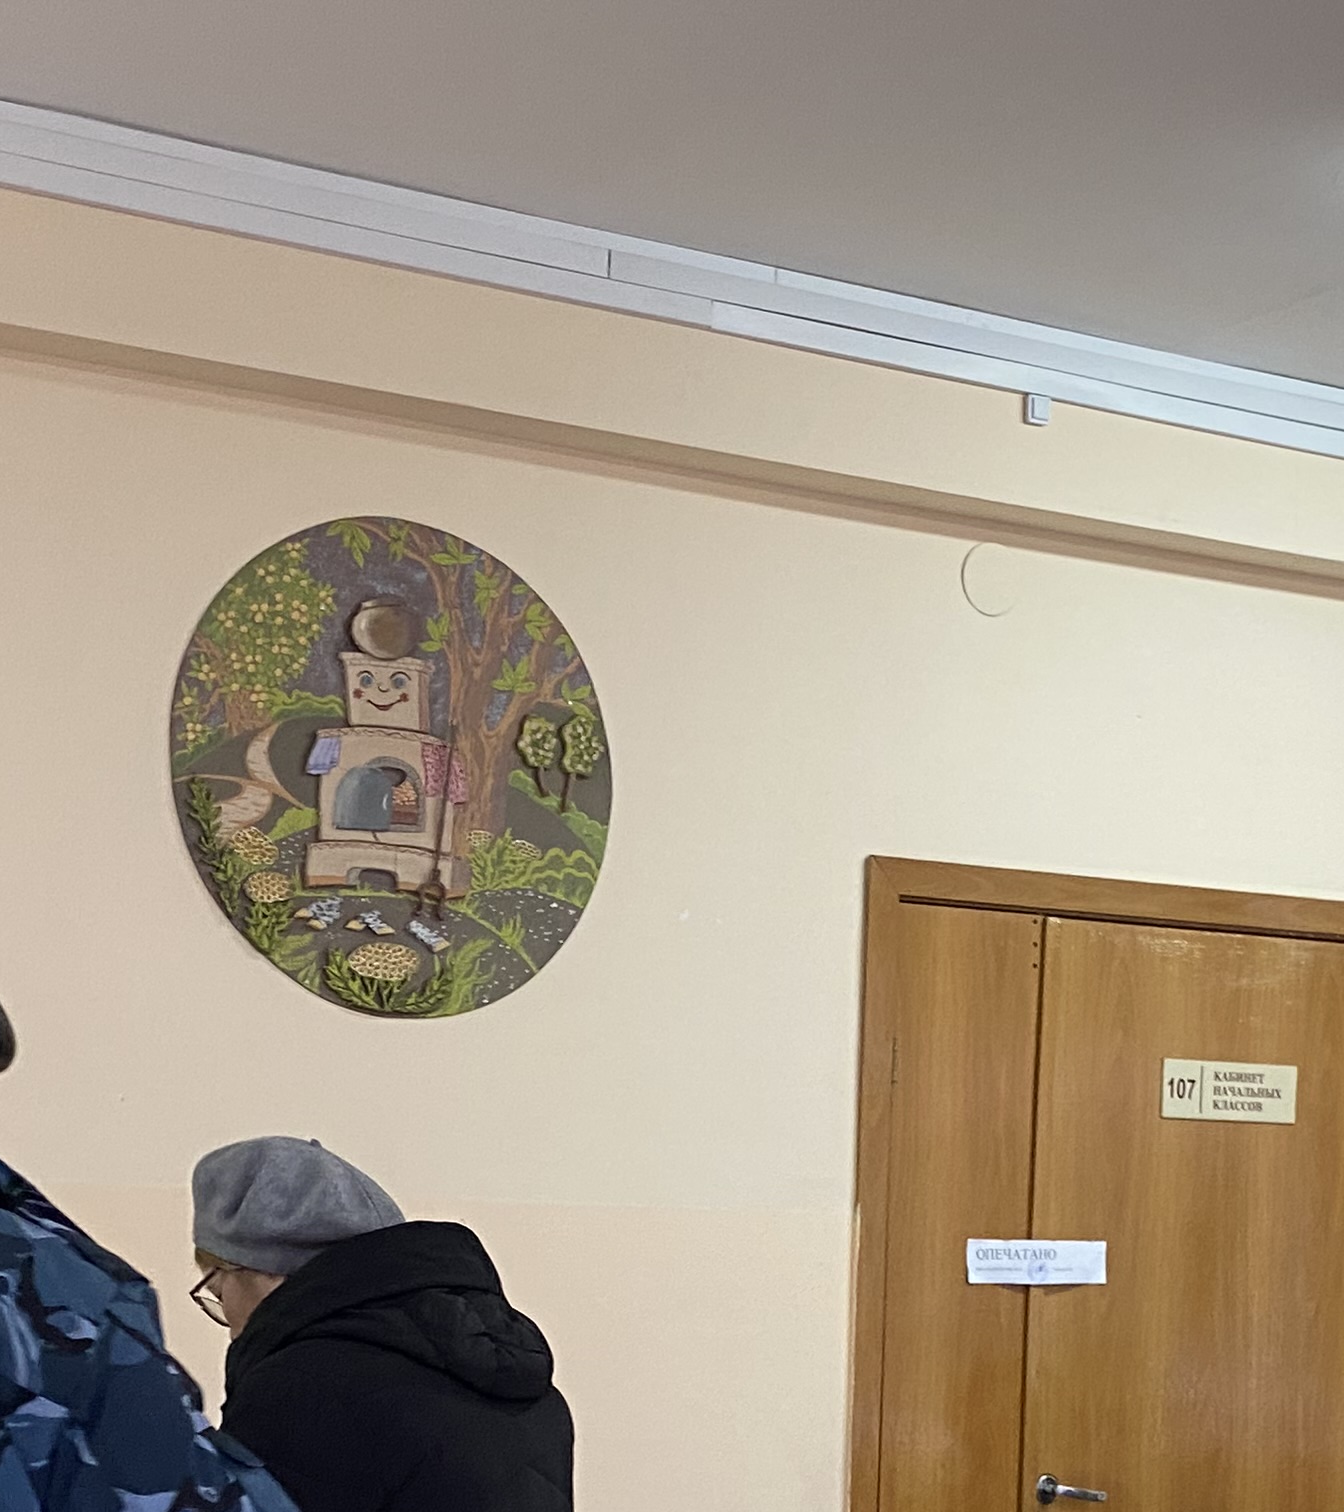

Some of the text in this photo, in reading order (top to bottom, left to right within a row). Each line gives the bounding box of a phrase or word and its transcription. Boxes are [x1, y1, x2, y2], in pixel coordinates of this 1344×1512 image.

[1213, 1071, 1265, 1084] КАБИНЕТ
[1167, 1077, 1196, 1100] 107
[1213, 1086, 1282, 1099] НАЧАЛЬНЫХ
[1213, 1099, 1263, 1112] КЛАССОВ
[975, 1247, 1057, 1261] ОПЕЧАТАНО
